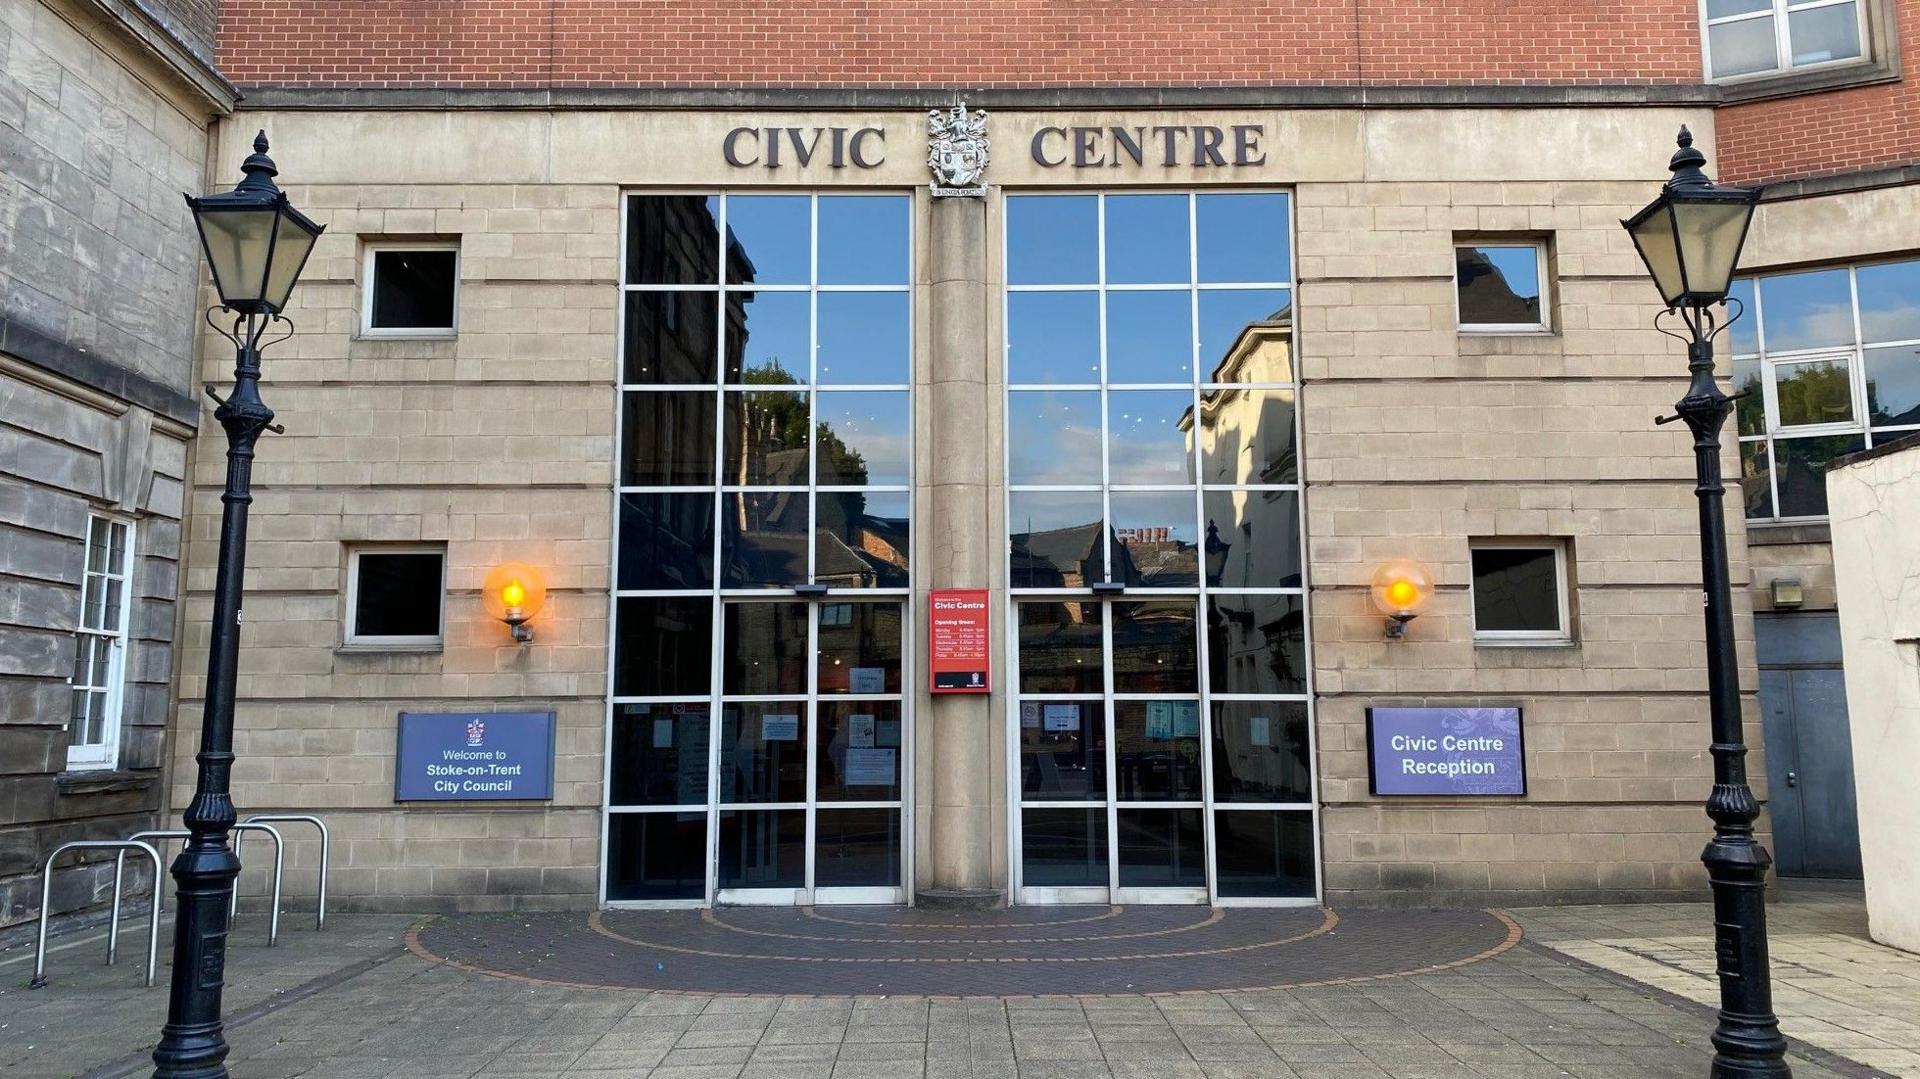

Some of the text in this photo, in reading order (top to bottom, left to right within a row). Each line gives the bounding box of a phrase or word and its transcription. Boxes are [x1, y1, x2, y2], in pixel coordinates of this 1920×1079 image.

[723, 124, 1267, 169] CIVIC CENTRE
[1391, 735, 1504, 751] Civic Centre
[443, 750, 506, 760] Welcome to
[426, 764, 521, 776] Stoke-on-Trent
[1402, 759, 1495, 778] Reception
[434, 780, 512, 794] City Council
